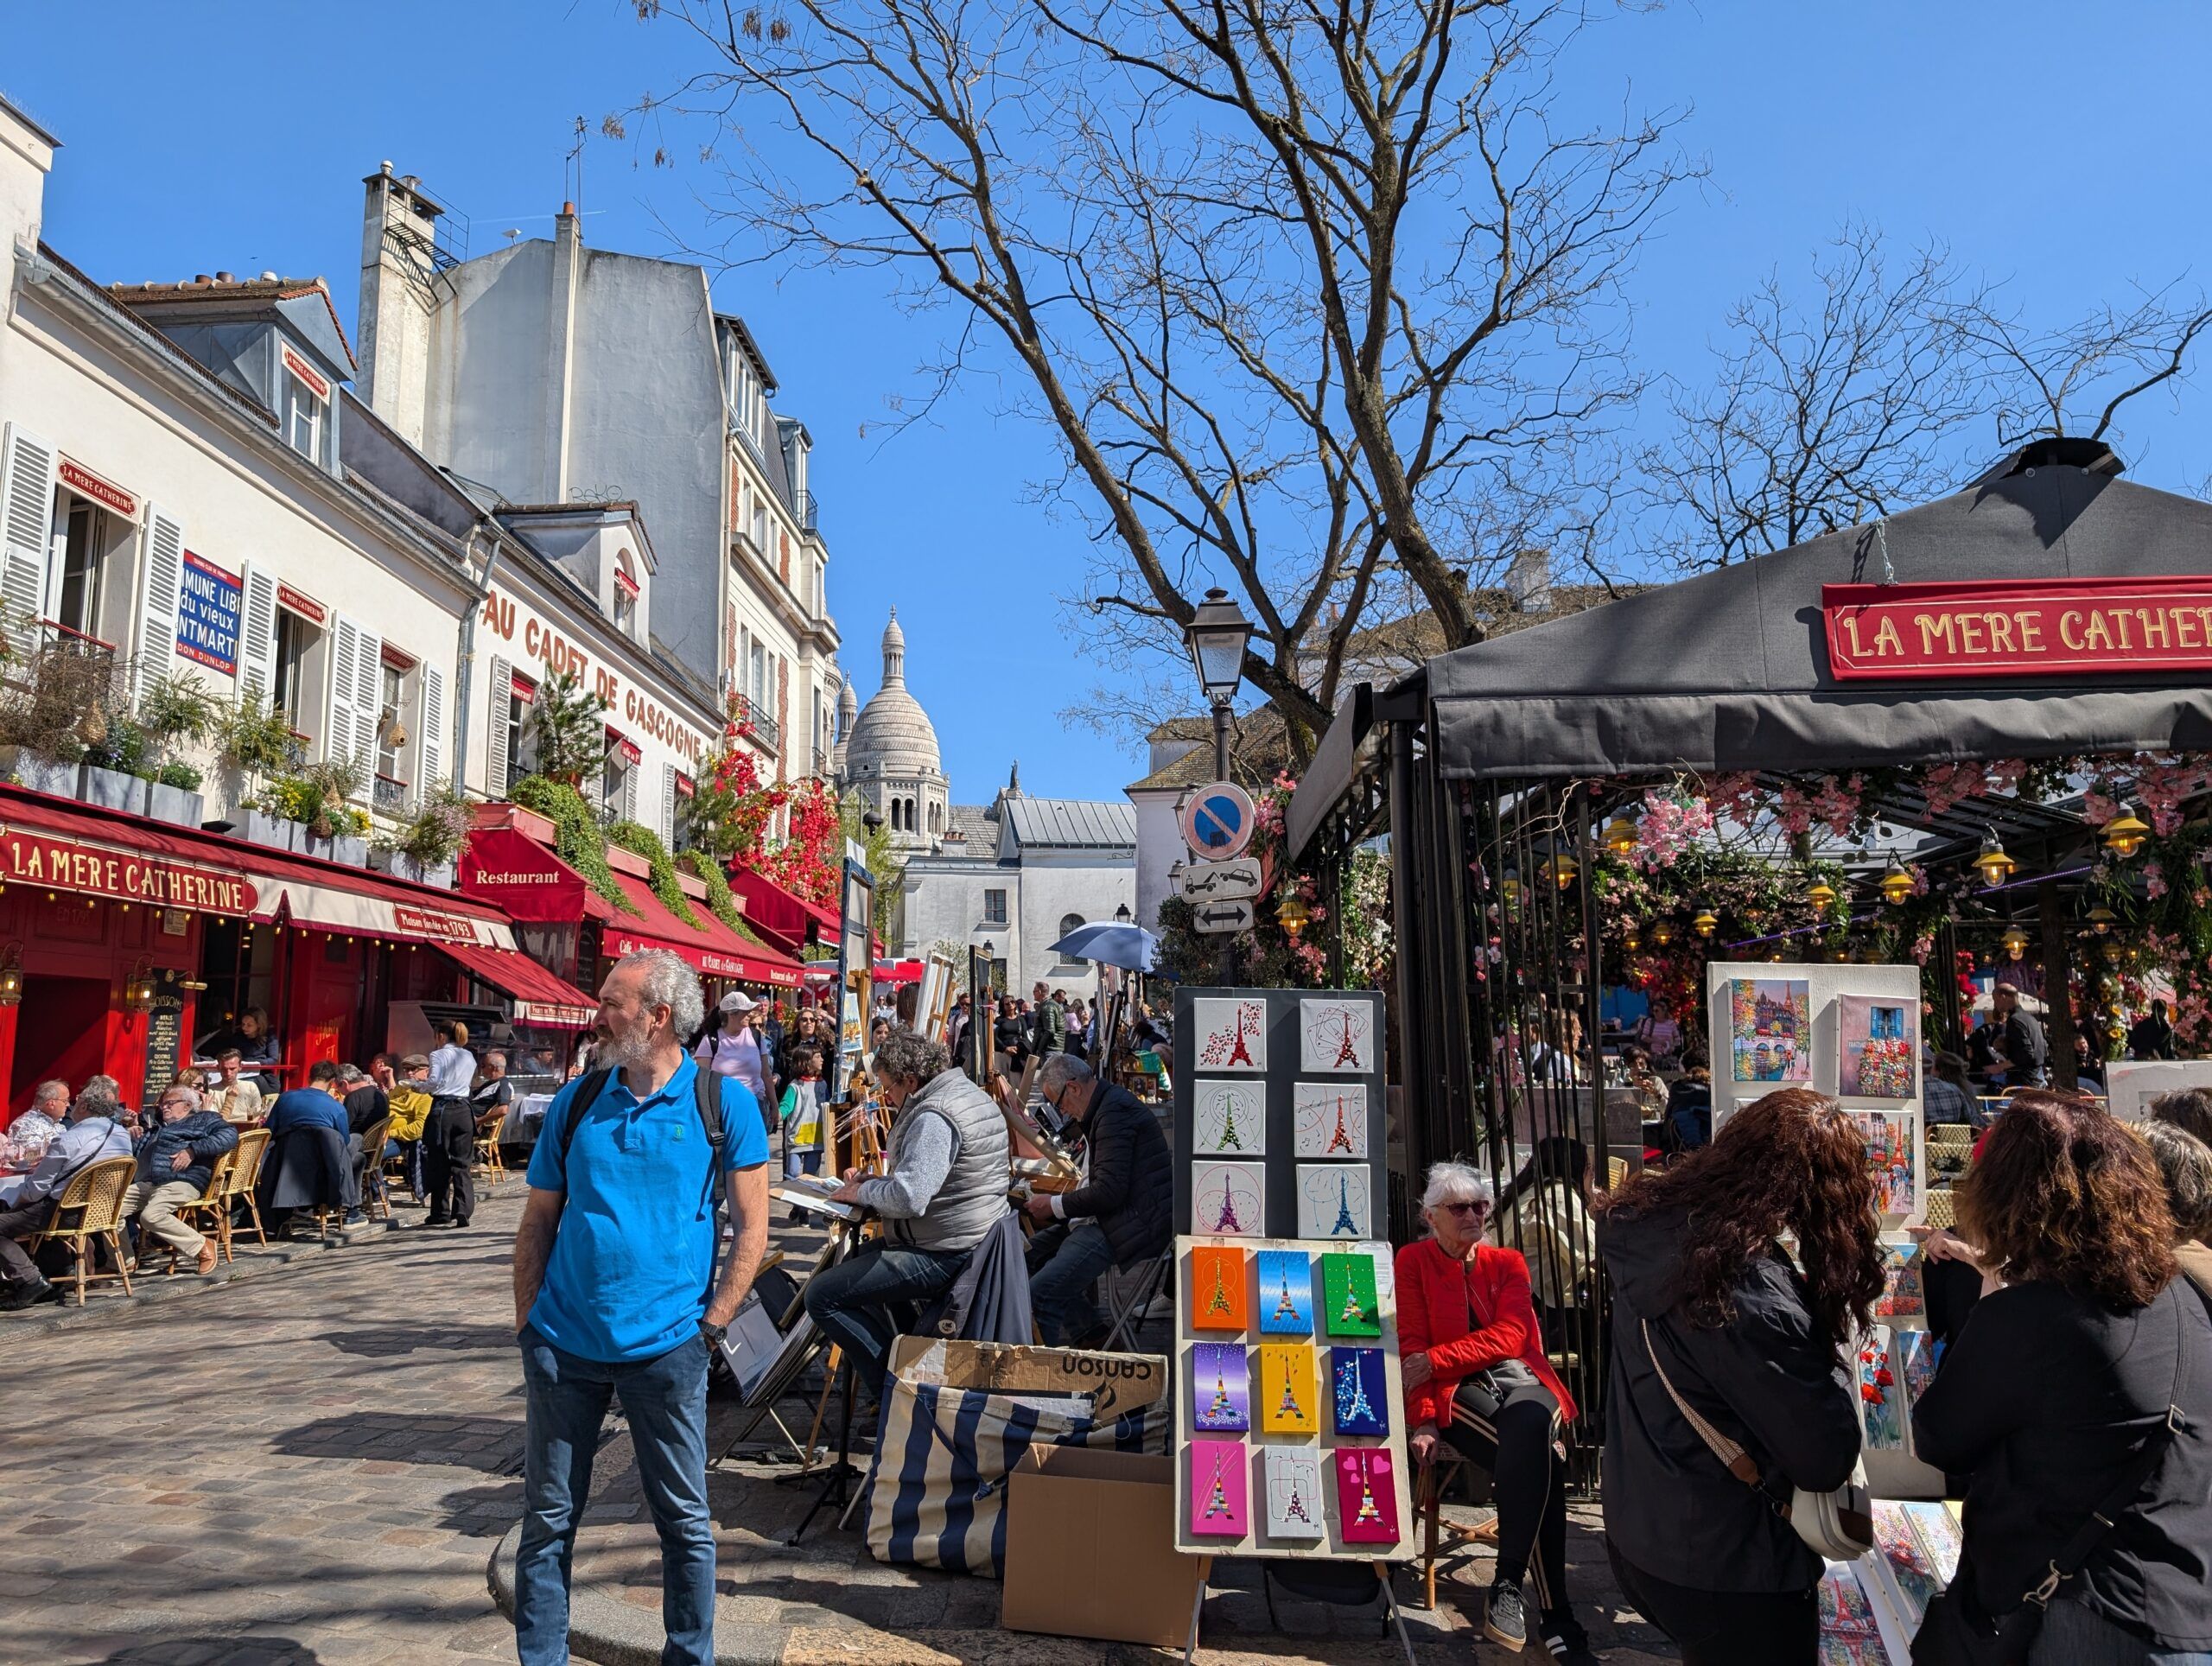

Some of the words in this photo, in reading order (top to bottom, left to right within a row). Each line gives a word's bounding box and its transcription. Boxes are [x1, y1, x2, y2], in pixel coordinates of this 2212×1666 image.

[63, 466, 73, 479] LA
[74, 472, 94, 491] MERE
[94, 484, 132, 512] CATHERINE
[180, 590, 196, 614] du
[200, 602, 234, 633] vieux
[1843, 614, 1905, 658] LA
[1914, 610, 2047, 655] MERE
[198, 652, 231, 671] DUNLOP
[482, 589, 516, 641] AU
[525, 618, 588, 690] CADET
[596, 667, 618, 711] DE
[626, 688, 702, 766] GASCOGNE
[12, 842, 44, 880] LA
[50, 849, 119, 892] MERE
[125, 863, 245, 911] CATHERINE
[475, 869, 560, 885] Restaurant
[400, 912, 423, 928] Maison
[449, 920, 471, 938] 1793
[620, 939, 632, 954] Café
